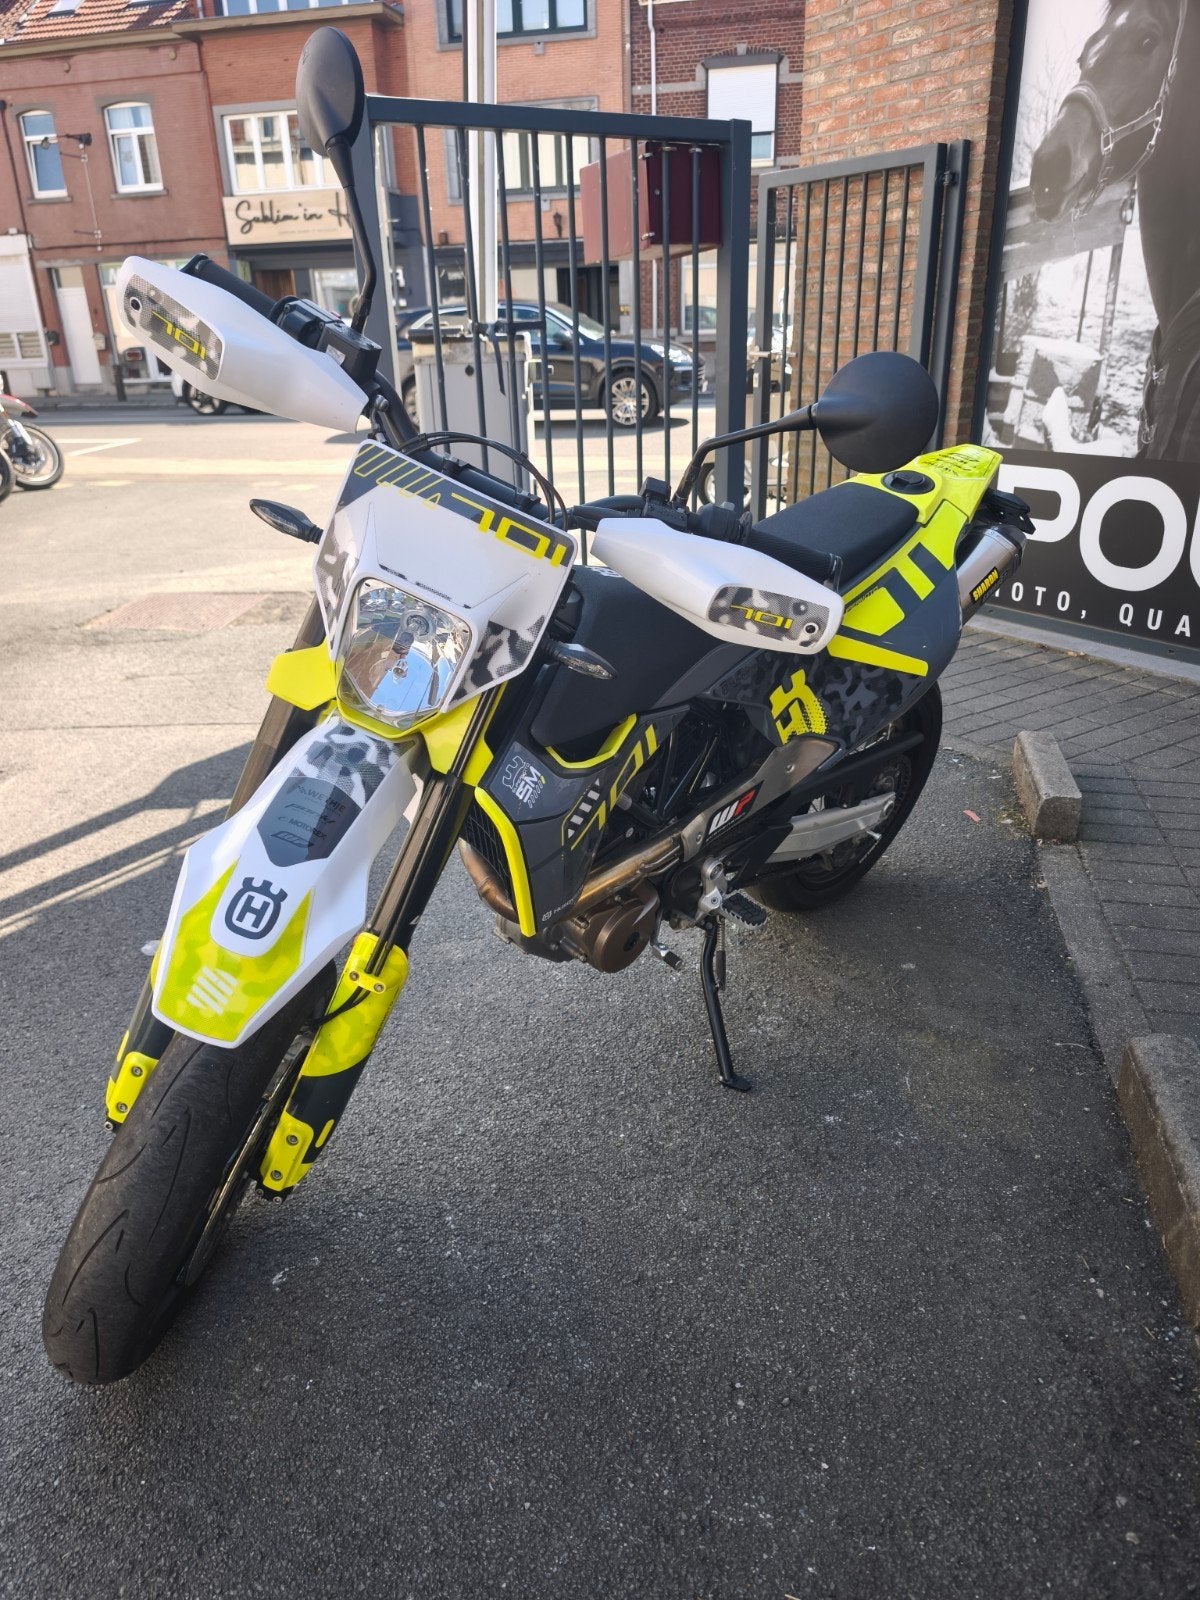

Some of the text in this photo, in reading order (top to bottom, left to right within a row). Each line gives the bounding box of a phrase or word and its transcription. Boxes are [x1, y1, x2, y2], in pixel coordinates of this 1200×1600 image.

[151, 310, 206, 360] 701
[451, 492, 567, 568] 701
[997, 463, 1200, 592] PO
[730, 604, 793, 630] 701
[994, 582, 1087, 619] OTO,
